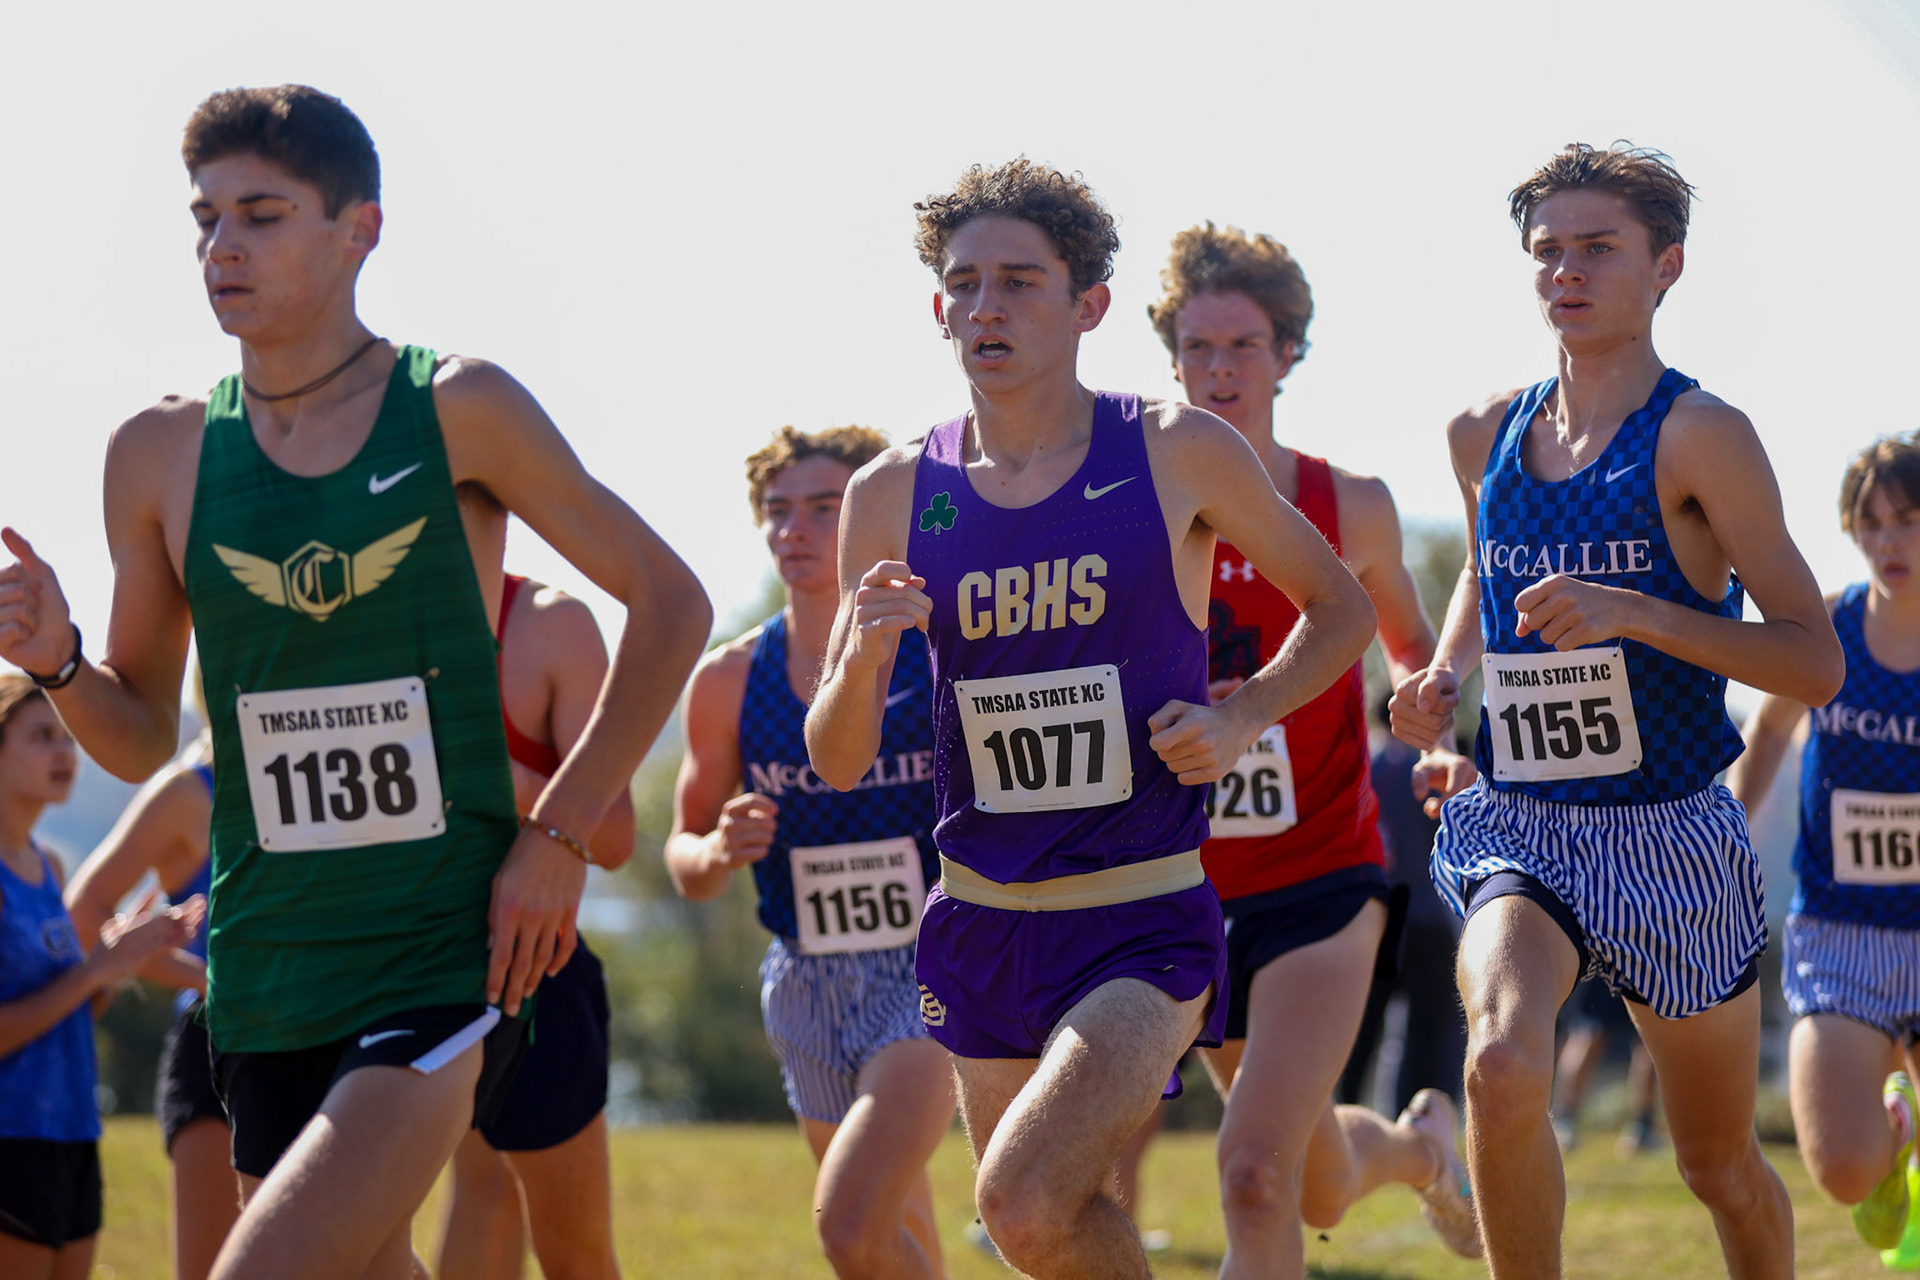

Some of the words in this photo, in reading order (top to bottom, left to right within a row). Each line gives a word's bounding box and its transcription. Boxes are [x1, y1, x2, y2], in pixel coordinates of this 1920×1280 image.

[957, 554, 1108, 641] CBHS
[971, 692, 1027, 715] TMSAA
[1028, 686, 1079, 710] STATE
[1080, 682, 1105, 703] XC
[1497, 667, 1541, 688] TMSAA
[1543, 666, 1588, 686] STATE
[1591, 663, 1612, 682] XC
[259, 709, 321, 735] TMSAA
[324, 704, 378, 730] STATE
[380, 699, 408, 724] XC
[1500, 697, 1621, 761] 1155
[983, 719, 1105, 791] 1077
[264, 743, 417, 825] 1138
[1844, 829, 1920, 870] 116
[807, 881, 912, 935] 1156
